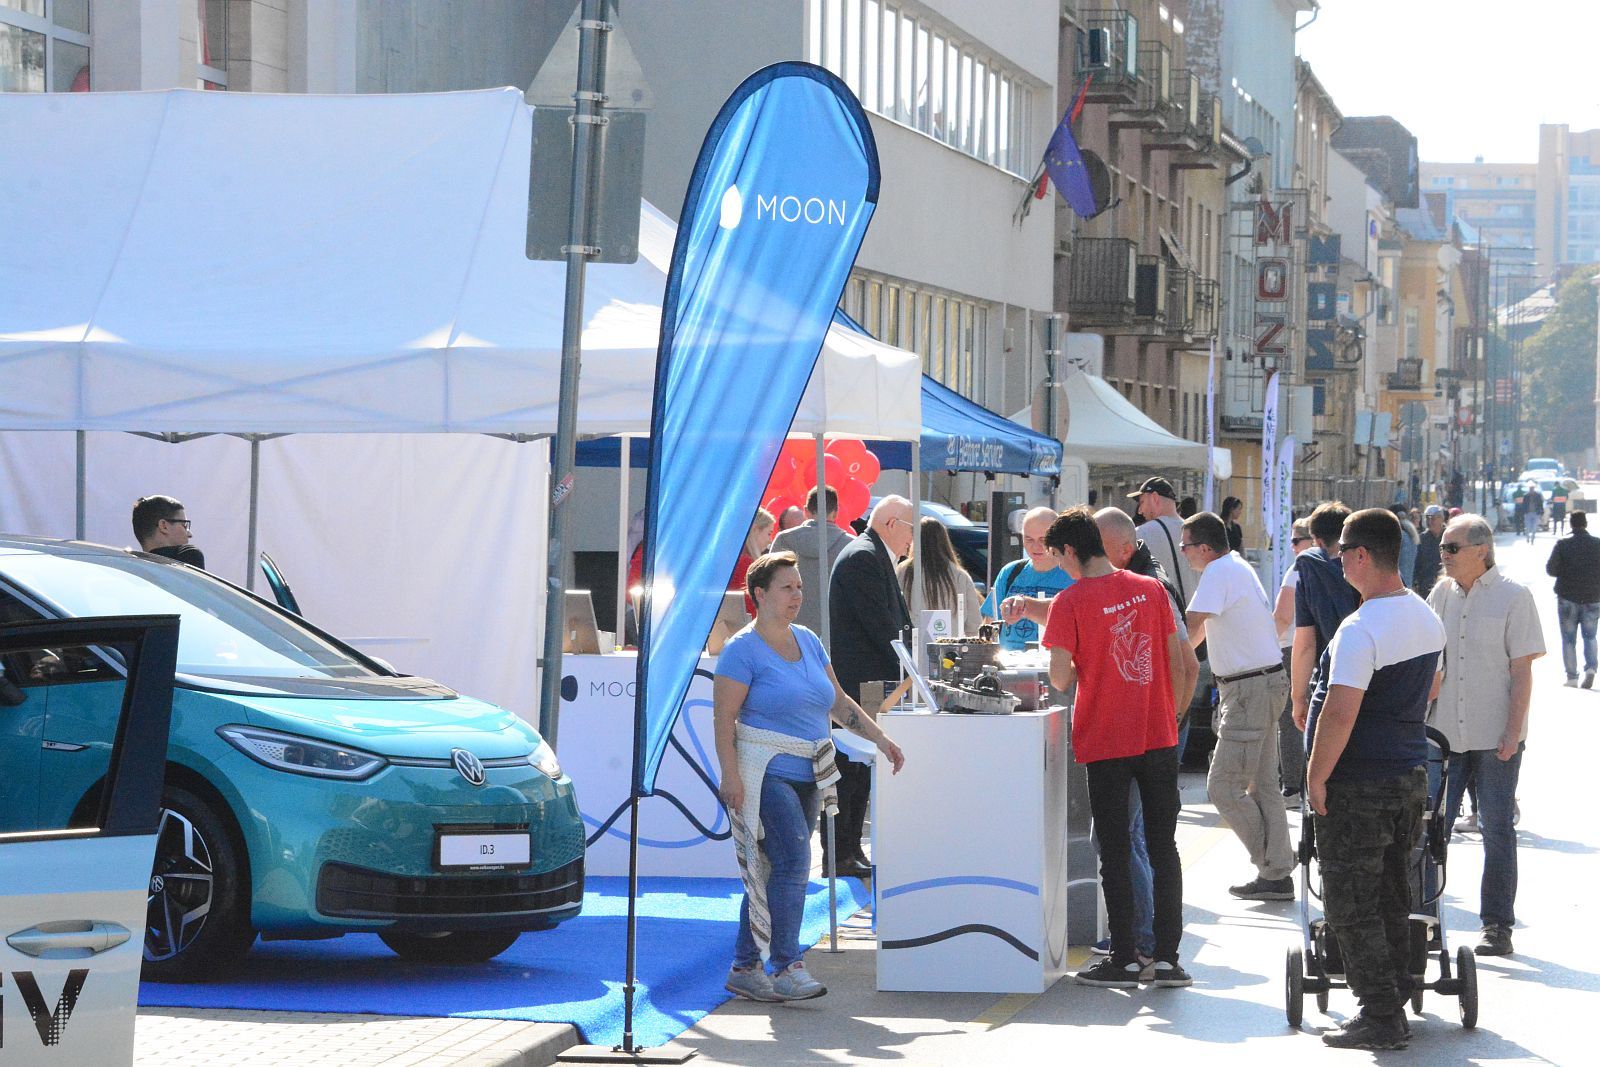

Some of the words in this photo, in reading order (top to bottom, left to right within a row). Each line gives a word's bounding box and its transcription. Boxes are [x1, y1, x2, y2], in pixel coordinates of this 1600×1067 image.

[757, 194, 846, 226] MOON
[590, 681, 637, 697] MOO
[480, 844, 495, 855] ID.3
[0, 968, 90, 1048] V
